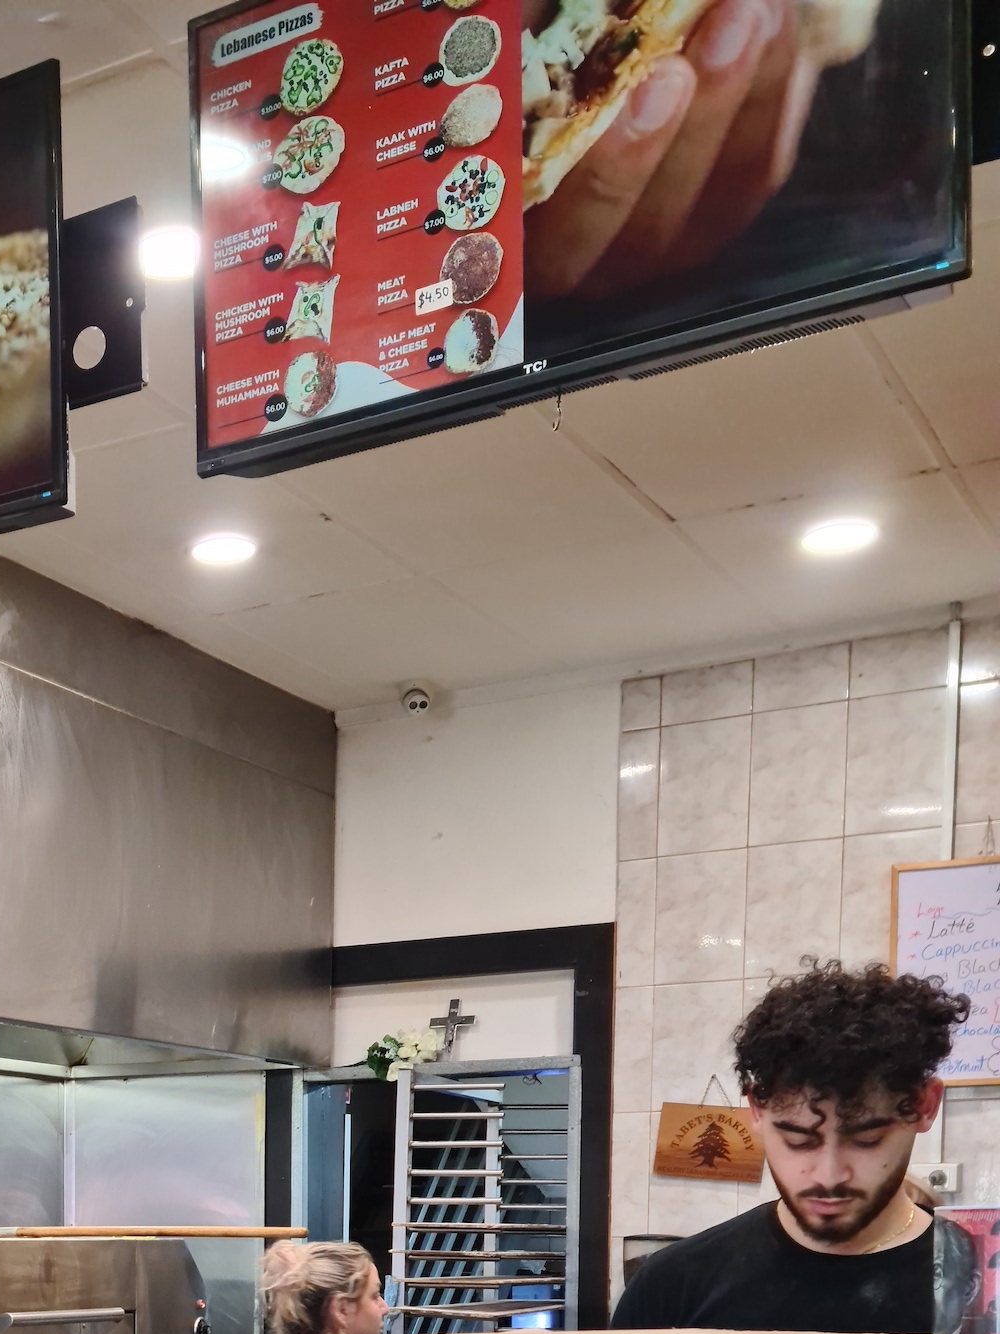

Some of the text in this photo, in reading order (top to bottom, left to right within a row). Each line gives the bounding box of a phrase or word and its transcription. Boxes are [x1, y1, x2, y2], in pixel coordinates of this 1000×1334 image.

[221, 12, 313, 58] Lebanese Pizzas
[374, 57, 409, 76] KAFTA
[375, 72, 406, 90] PIZZA
[423, 70, 444, 83] $6.00
[210, 80, 252, 102] CHICKEN
[210, 98, 239, 115] PIZZA
[261, 102, 282, 115] $10.00
[376, 120, 436, 149] KAAK WITH
[376, 141, 416, 162] CHEESE
[424, 144, 444, 158] $6.00
[262, 171, 282, 184] $7.00
[376, 198, 419, 220] LABNEH
[377, 216, 408, 234] PIZZA
[424, 216, 444, 230] $7.00
[214, 221, 278, 248] CHEESE WITH
[214, 234, 269, 259] MUSHROOM
[214, 254, 242, 270] PIZZA
[265, 252, 283, 264] $5.00
[378, 275, 406, 292] MEAT
[378, 288, 408, 306] PIZZA
[418, 286, 449, 309] $4.50
[216, 292, 284, 321] CHICKEN WITH
[216, 307, 270, 332] MUSHROOM
[216, 327, 244, 342] PIZZA
[266, 325, 284, 338] $6.00
[378, 322, 436, 348] HALF MEAT
[379, 338, 428, 361] & CHEESE
[378, 357, 410, 372] PIZZA
[216, 370, 280, 395] CHEESE WITH
[216, 383, 280, 408] MUHAMMARA
[266, 402, 286, 414] $6.00
[970, 1005, 988, 1016] ea
[670, 1114, 754, 1152] TABET'S BAKERY
